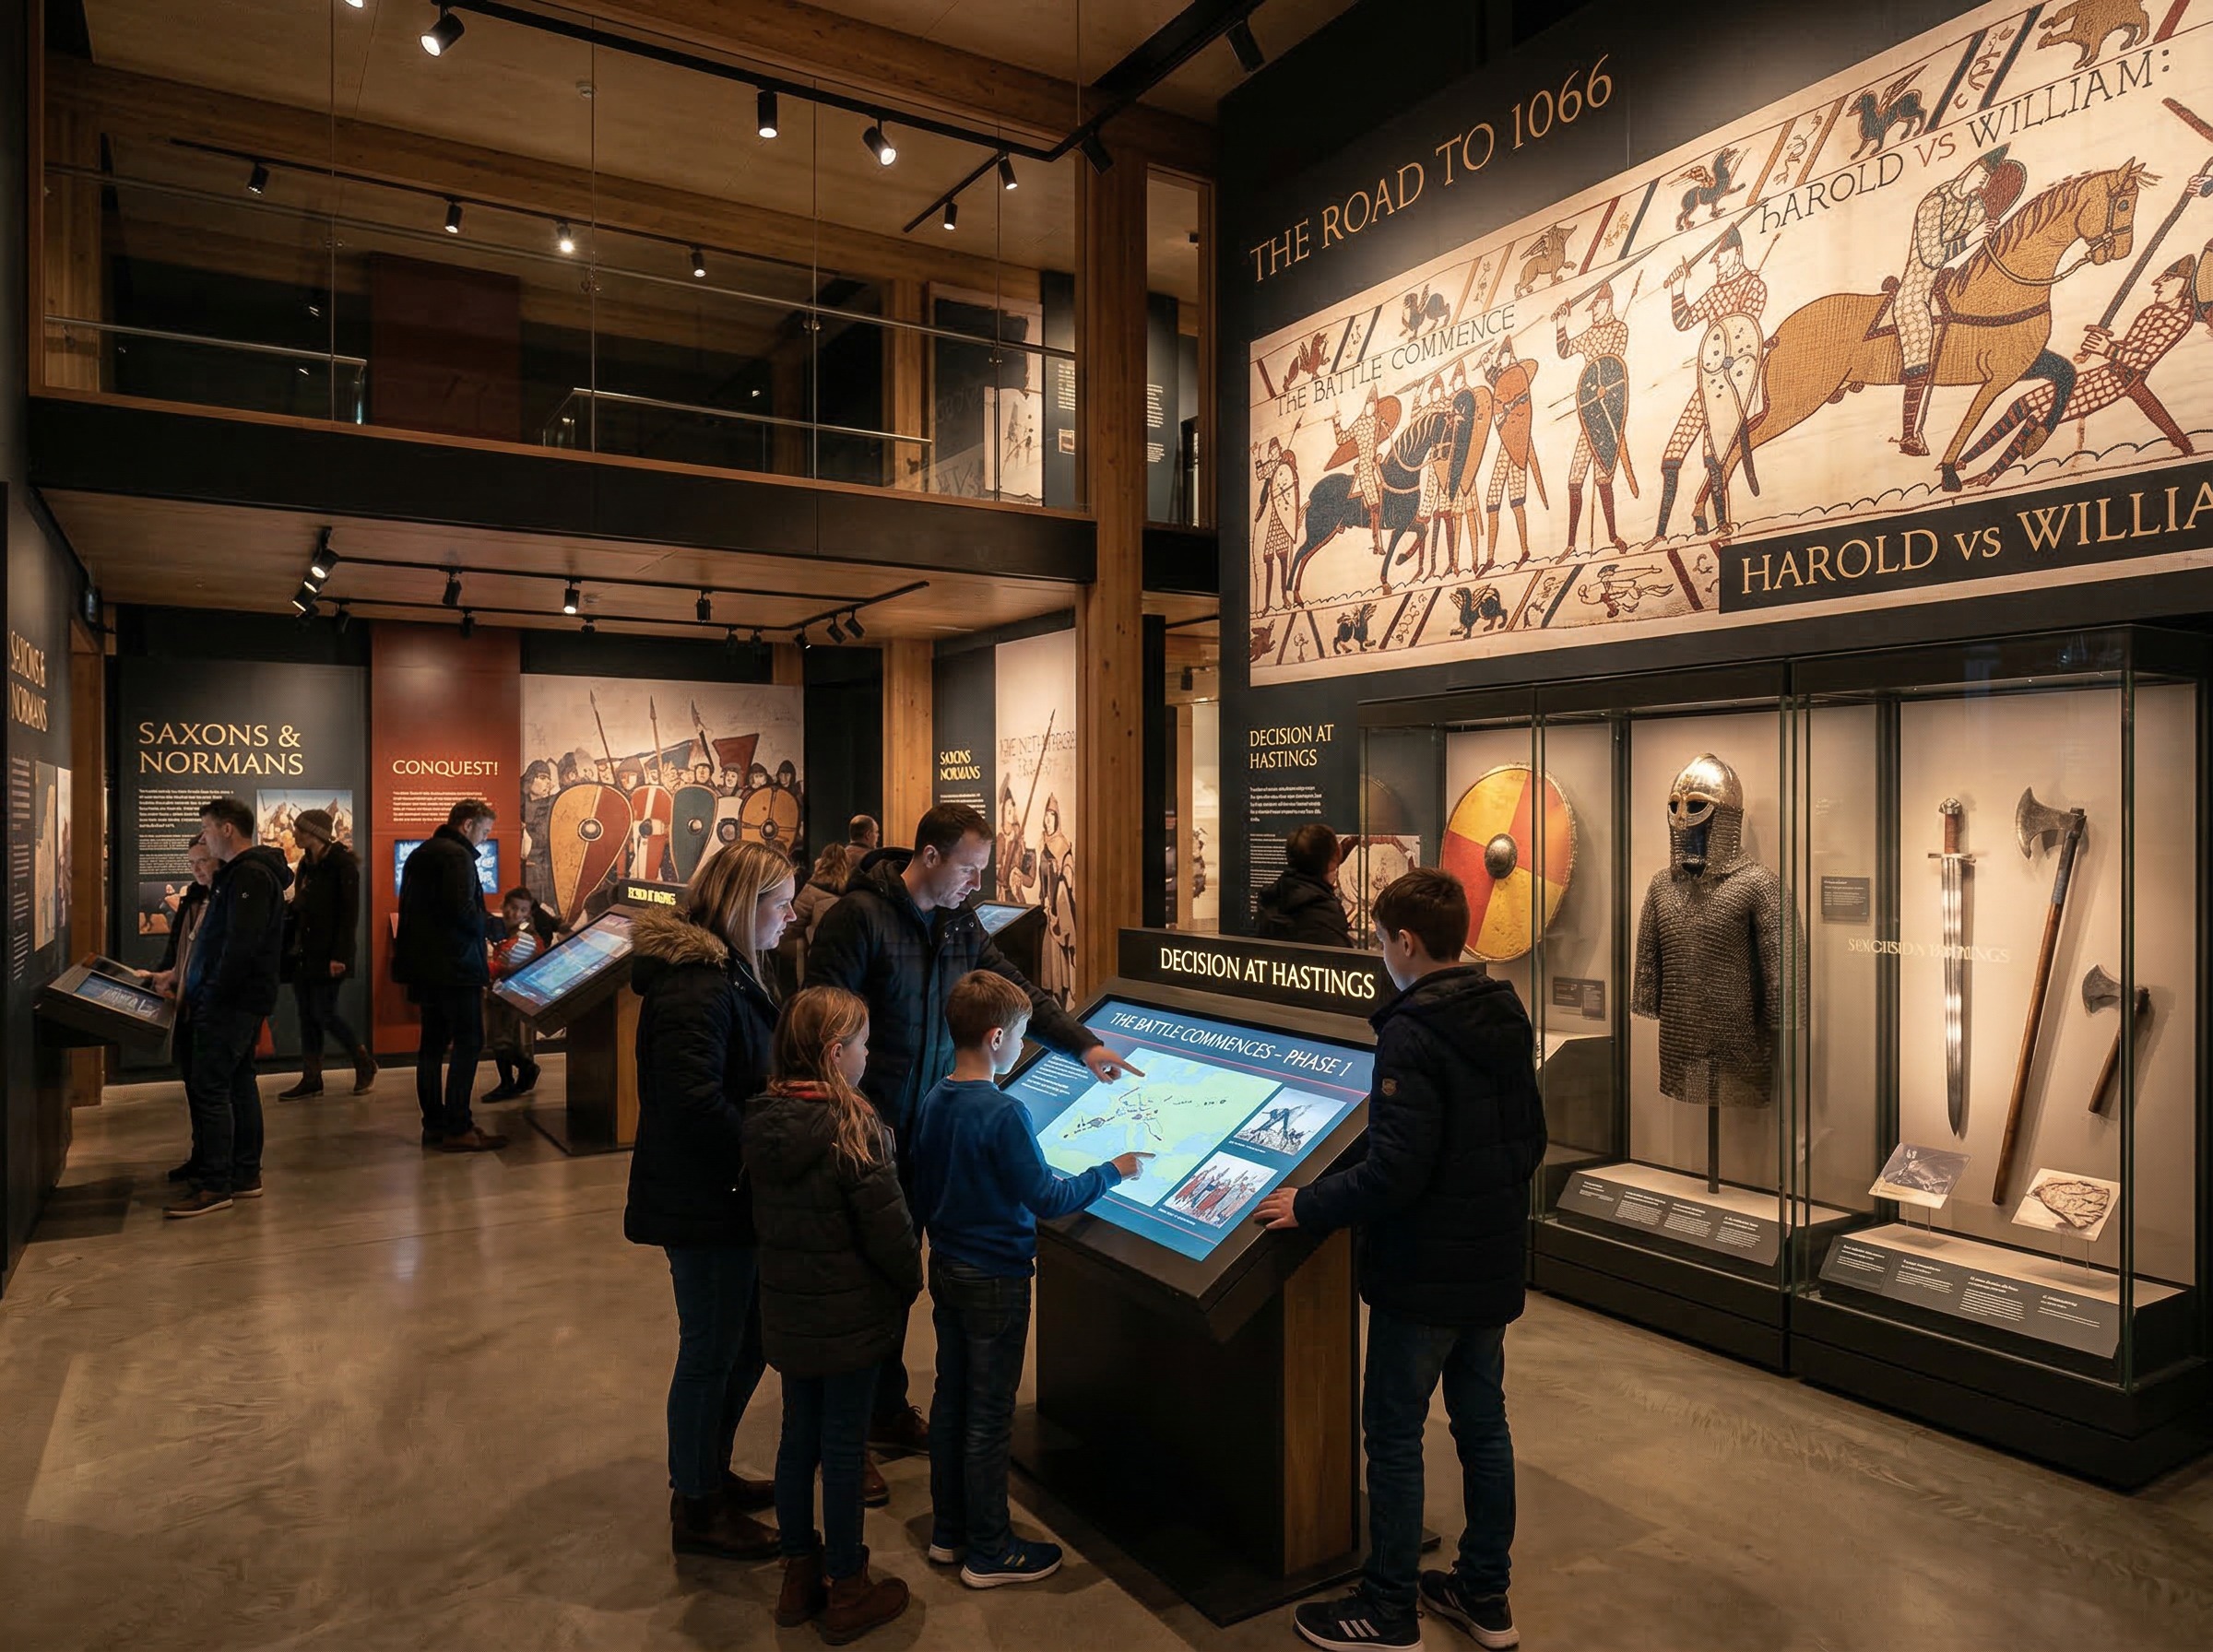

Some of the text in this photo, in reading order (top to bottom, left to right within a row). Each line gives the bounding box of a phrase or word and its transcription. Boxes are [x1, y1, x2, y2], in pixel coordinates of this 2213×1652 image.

[1249, 53, 1613, 283] THE ROAD TO 1066
[1913, 133, 1957, 168] VS
[1313, 356, 1382, 404] BATTLE
[1391, 304, 1516, 371] COMMENCE
[1741, 529, 1938, 595] HAROLD
[138, 722, 302, 748] SAXONS &
[1249, 724, 1335, 747] DECISION AT
[139, 750, 304, 775] NORMANS
[392, 760, 499, 778] CONQUEST!
[1249, 749, 1318, 770] HASTINGS
[1160, 947, 1376, 1000] DECISION AT HASTINGS
[1109, 1012, 1137, 1029] THE
[1132, 1017, 1184, 1039] BATTLE
[1180, 1028, 1276, 1059] COMMENCES
[1283, 1049, 1344, 1074] PHASE
